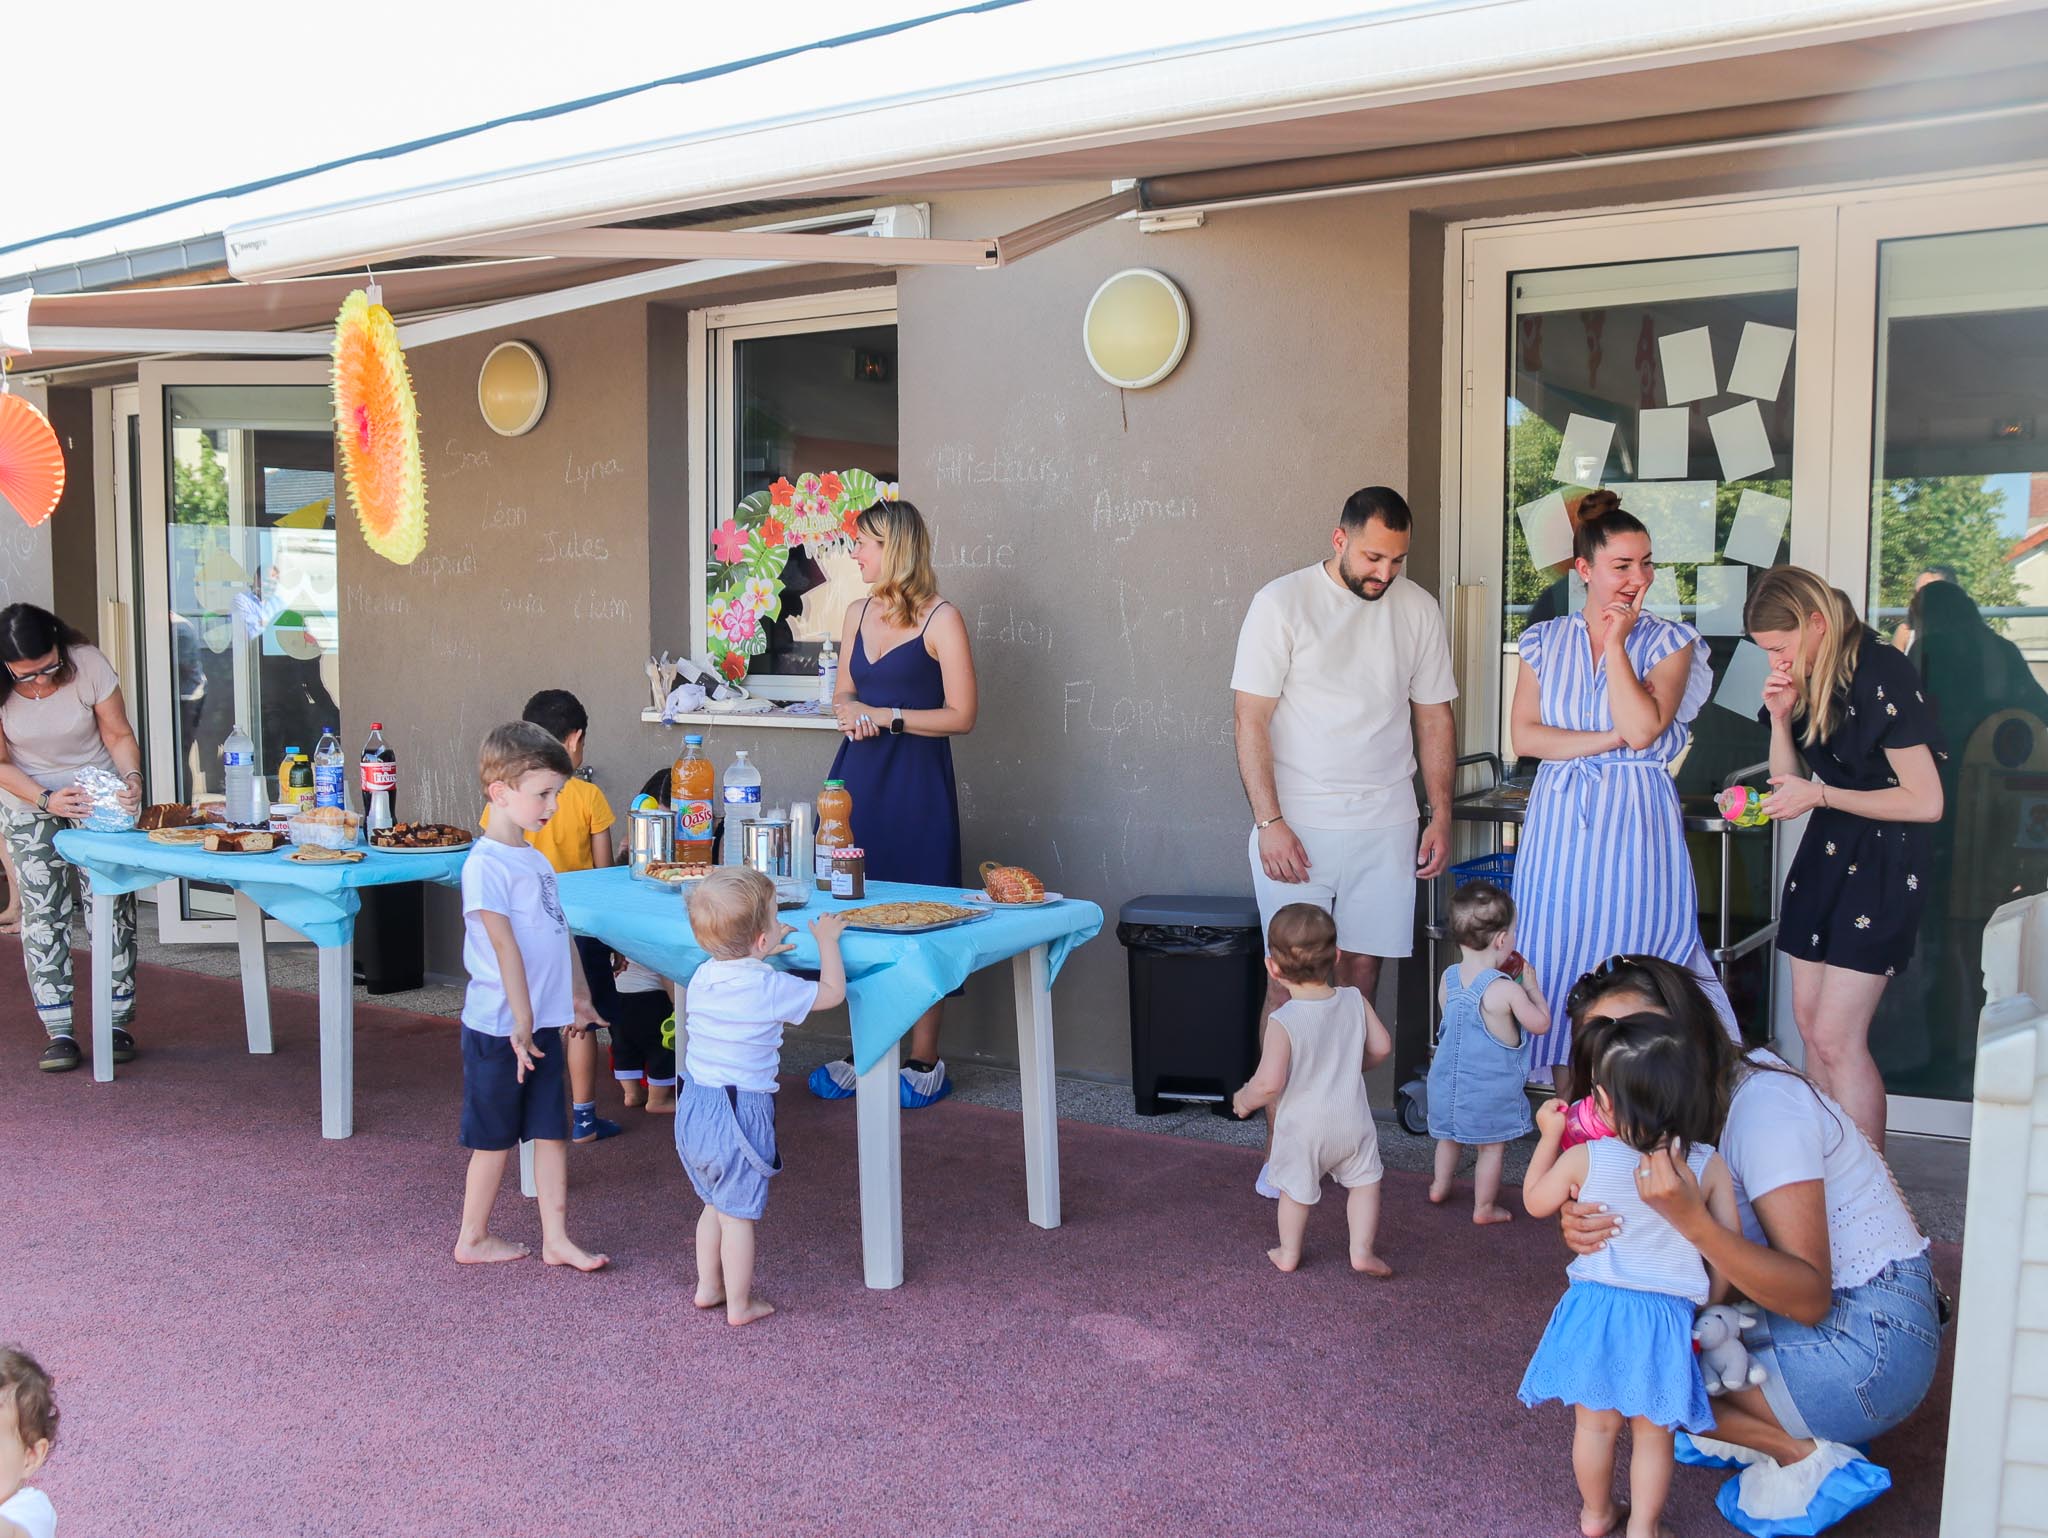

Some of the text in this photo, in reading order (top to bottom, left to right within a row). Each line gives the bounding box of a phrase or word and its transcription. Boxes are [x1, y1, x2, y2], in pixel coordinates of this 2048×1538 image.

[563, 450, 625, 495] Lyna
[536, 529, 609, 564] Jules
[931, 522, 1017, 570] Lucie
[976, 603, 1057, 653] Eden
[682, 809, 713, 829] Oasis
